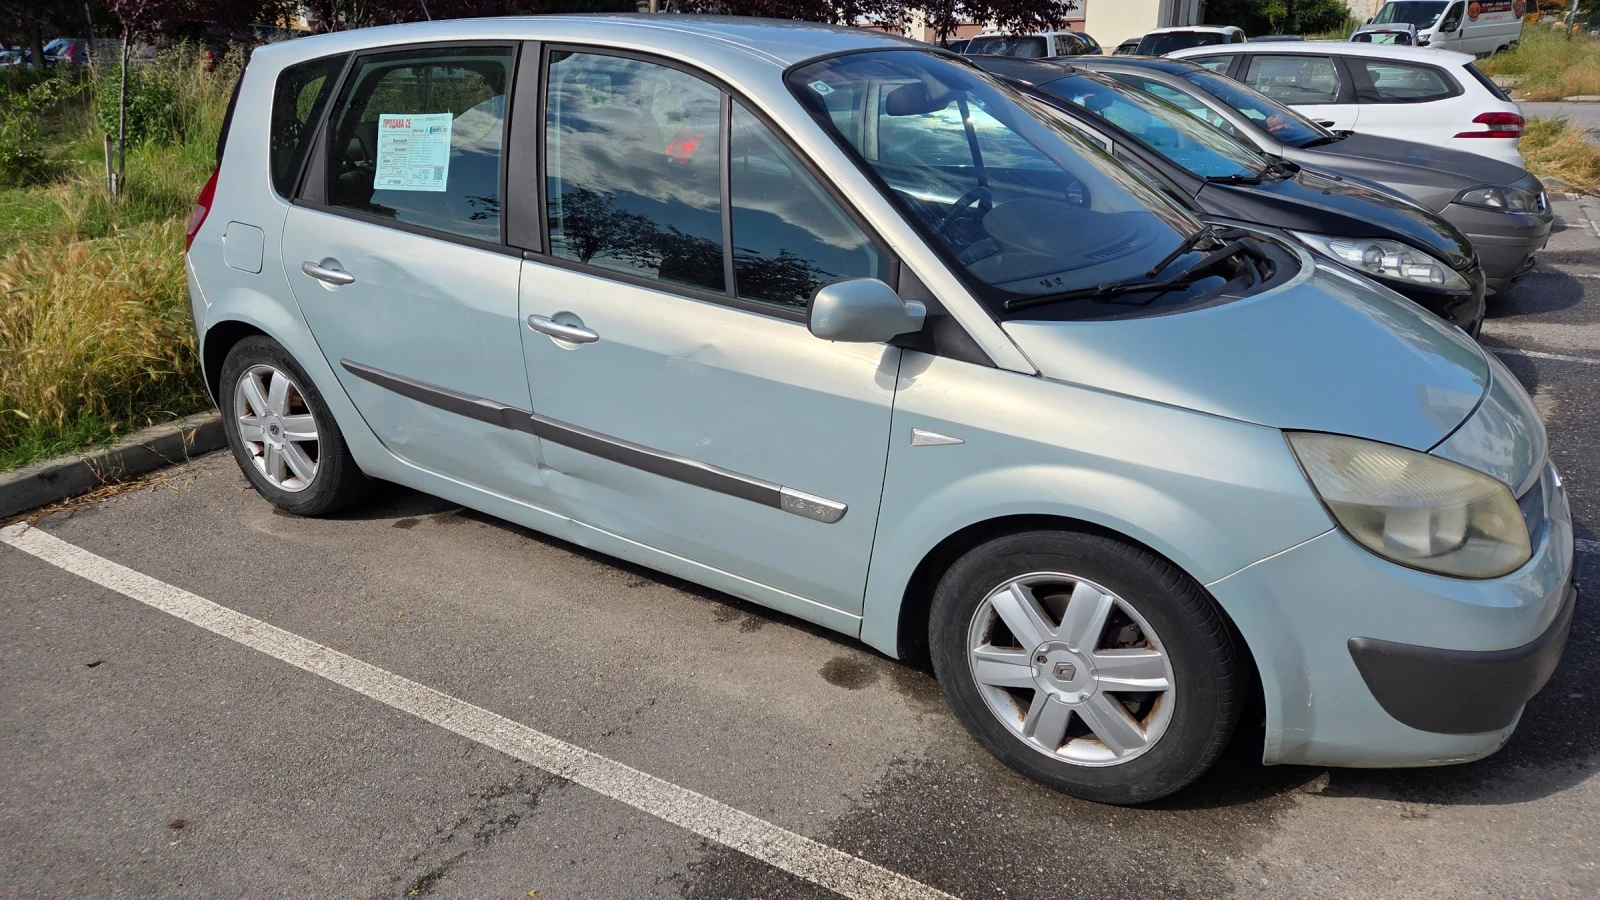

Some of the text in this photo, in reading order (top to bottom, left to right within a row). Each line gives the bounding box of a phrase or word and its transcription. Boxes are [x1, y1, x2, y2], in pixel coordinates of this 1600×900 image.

[383, 119, 411, 129] ПРОДАВА СЕ
[784, 496, 833, 516] 1.6 16V
